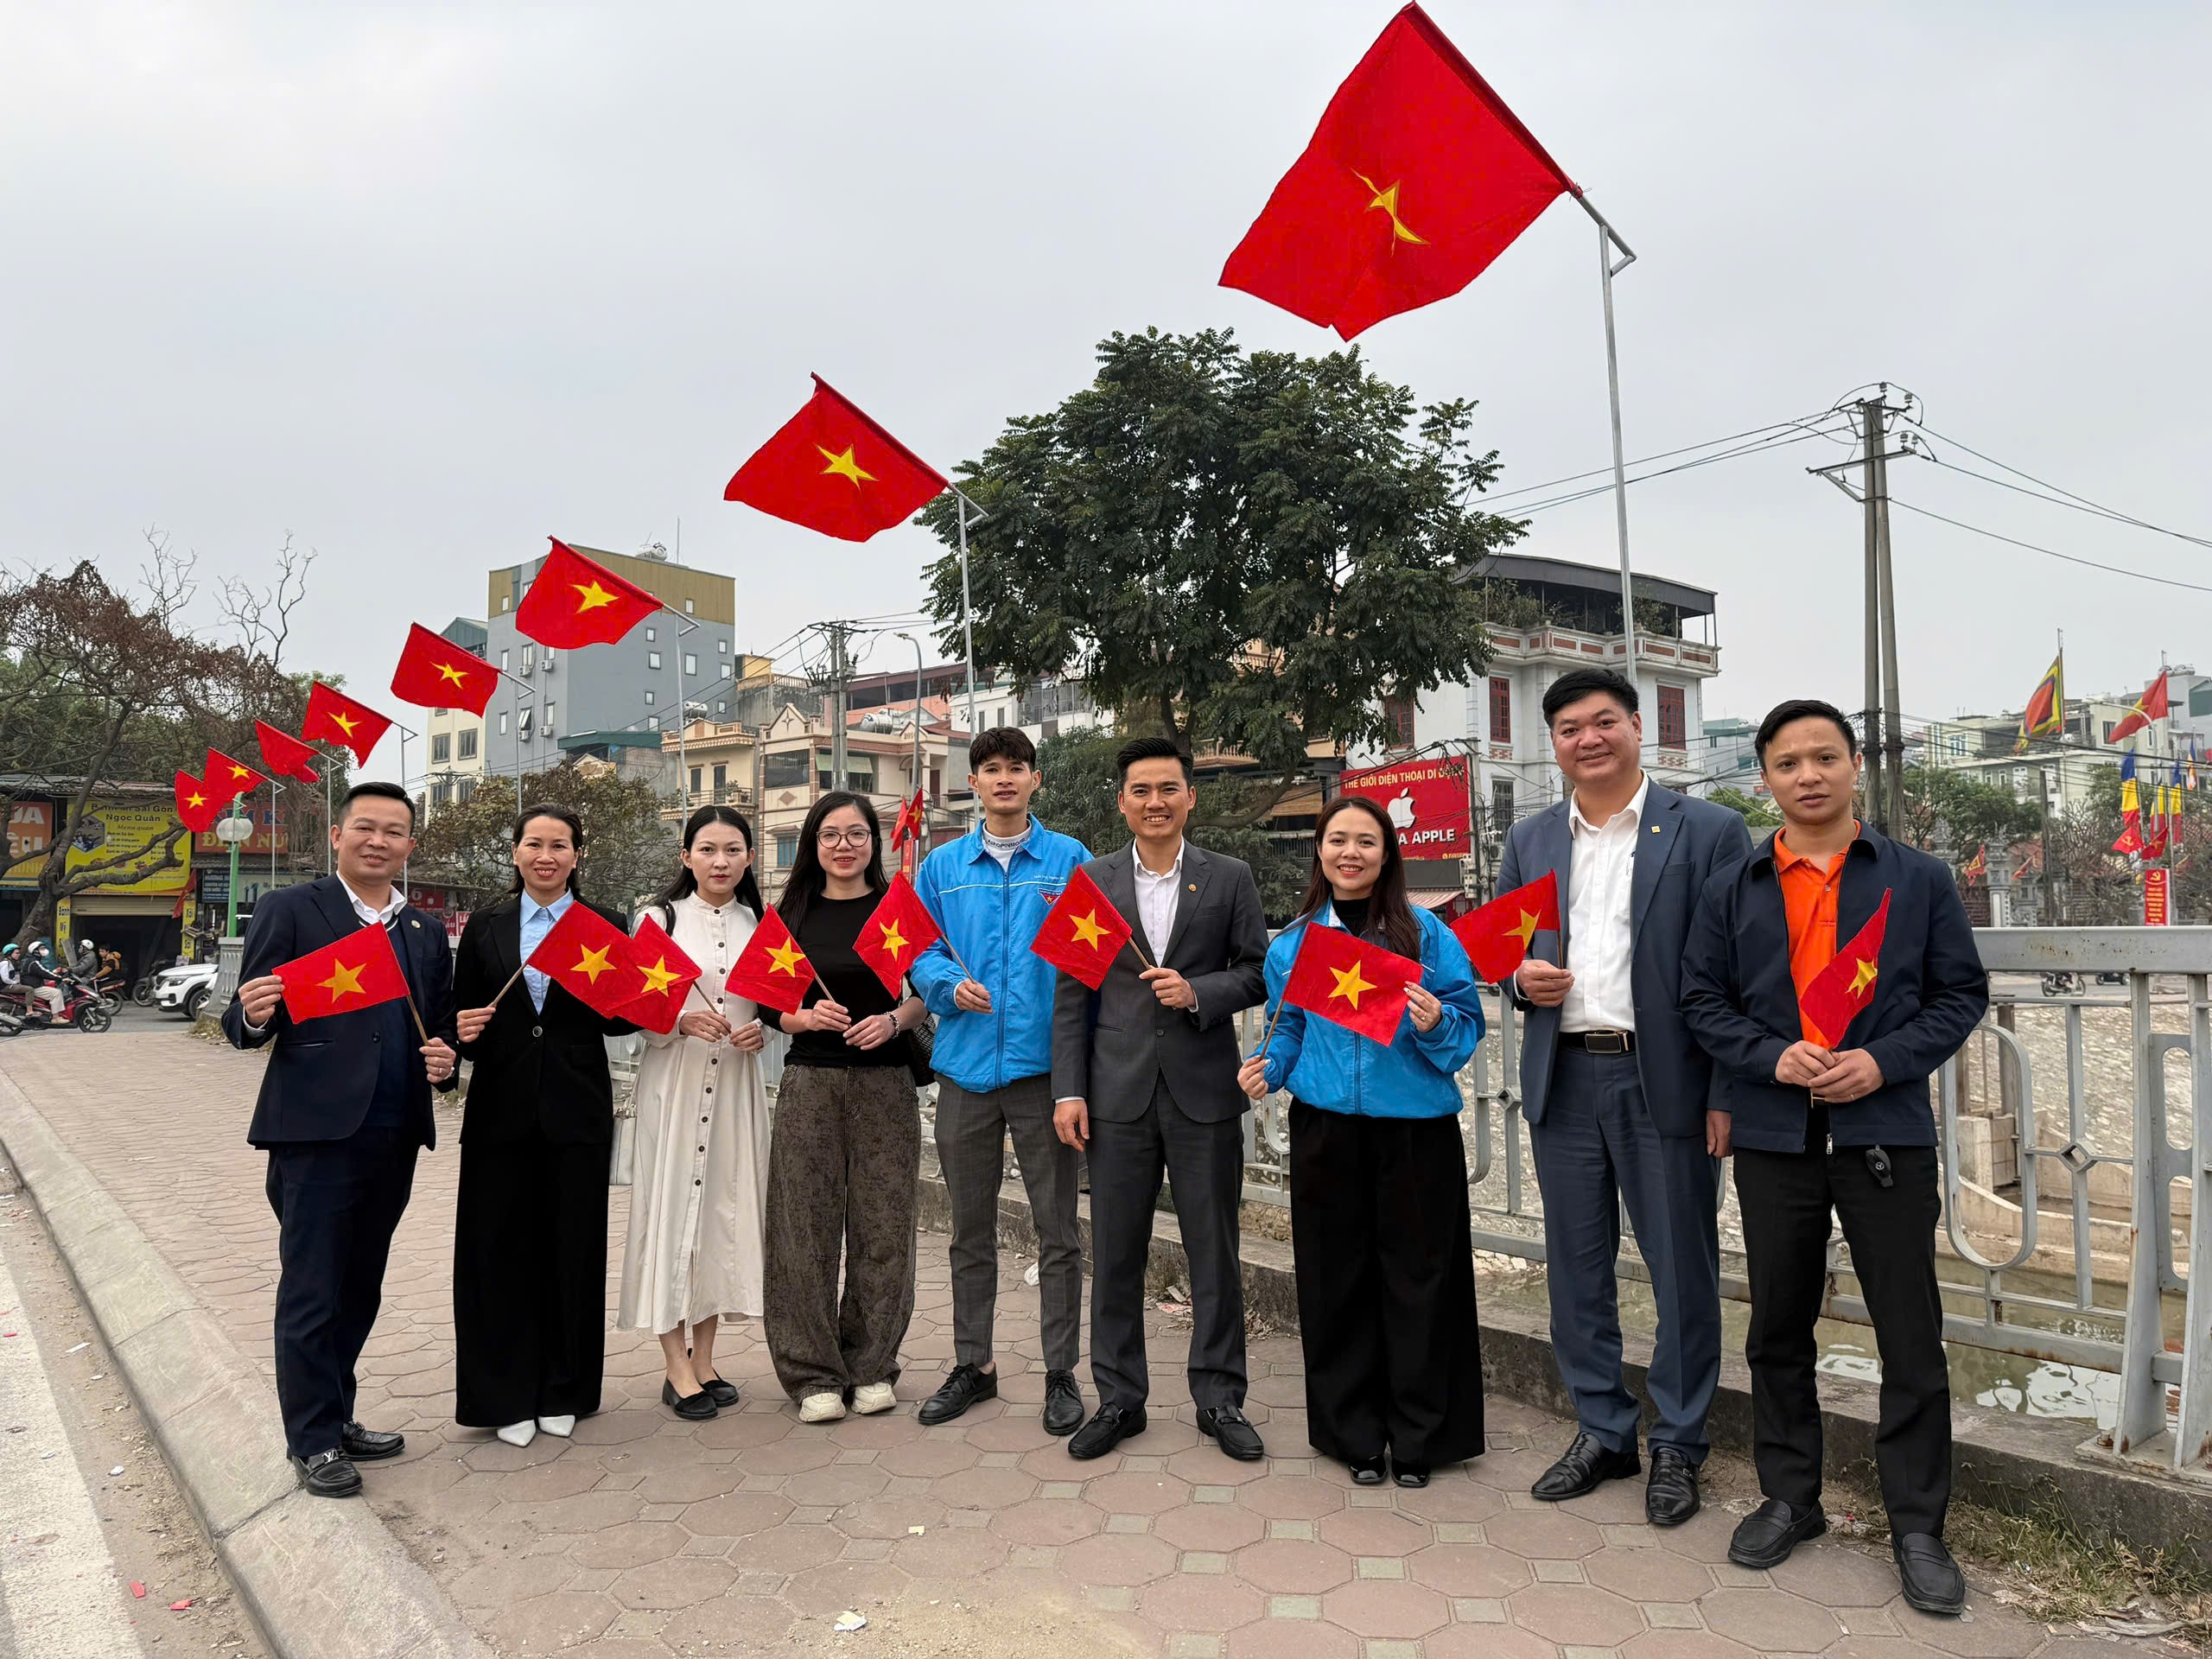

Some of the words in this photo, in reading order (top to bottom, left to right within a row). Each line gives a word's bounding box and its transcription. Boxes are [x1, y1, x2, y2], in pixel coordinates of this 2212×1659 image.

[1378, 772, 1398, 787] ĐIỆN
[1400, 769, 1426, 783] THOẠI
[1427, 768, 1437, 779] DI
[1412, 829, 1455, 844] APPLE
